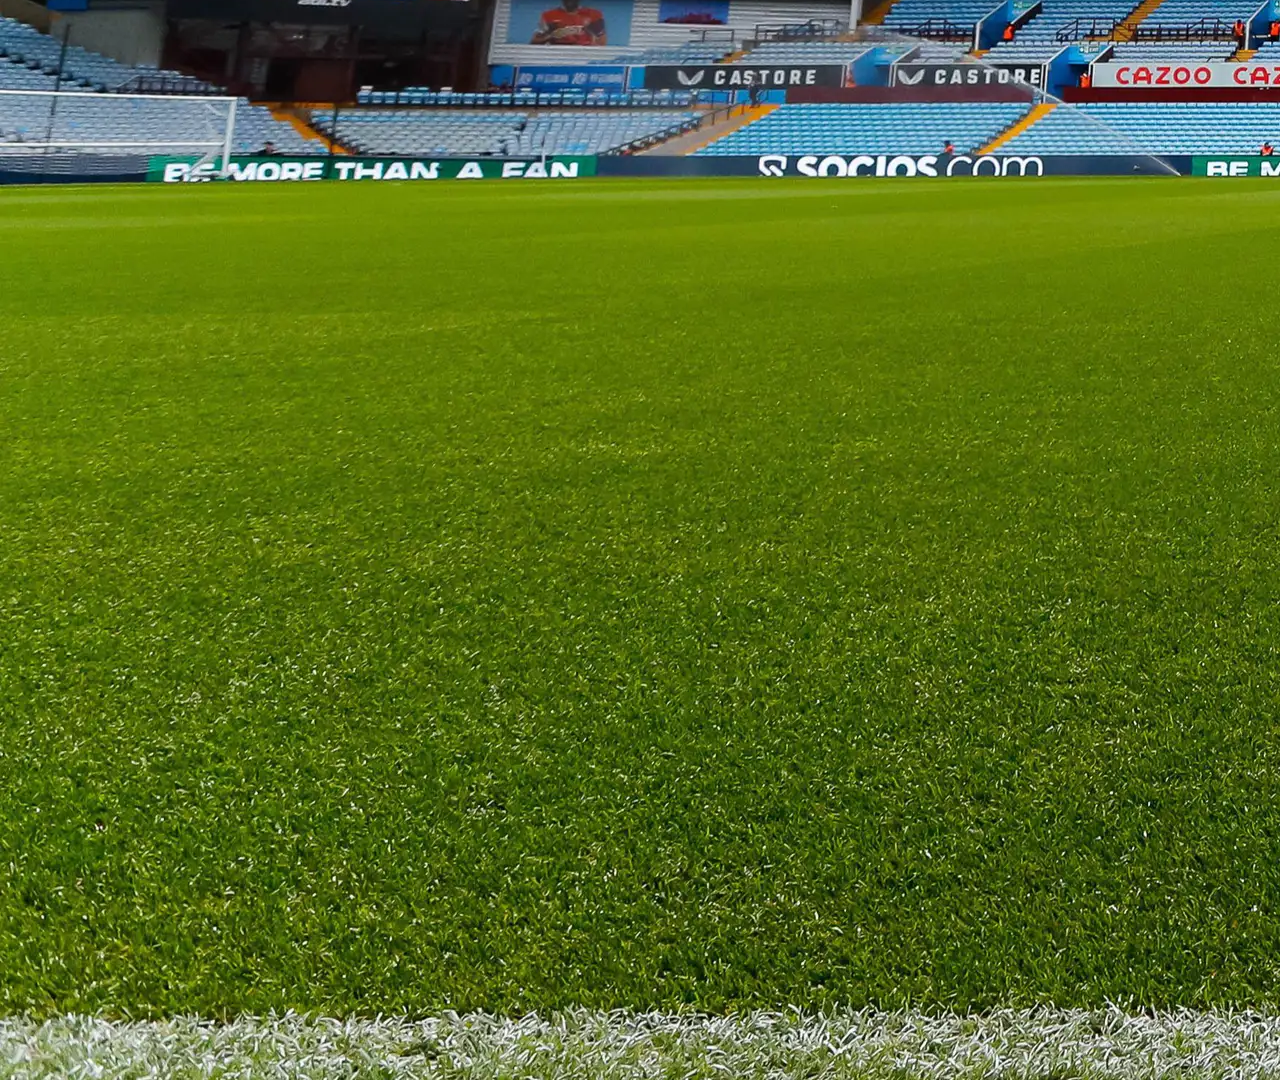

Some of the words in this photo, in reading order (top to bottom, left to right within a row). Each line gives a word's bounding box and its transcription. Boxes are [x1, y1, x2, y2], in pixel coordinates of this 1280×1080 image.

[714, 69, 817, 85] CASTORE
[934, 68, 1041, 84] CASTORE
[1115, 67, 1212, 85] CAZOO
[228, 162, 325, 181] MORE
[334, 162, 441, 179] THAN
[455, 162, 485, 179] A
[501, 162, 579, 177] FAN
